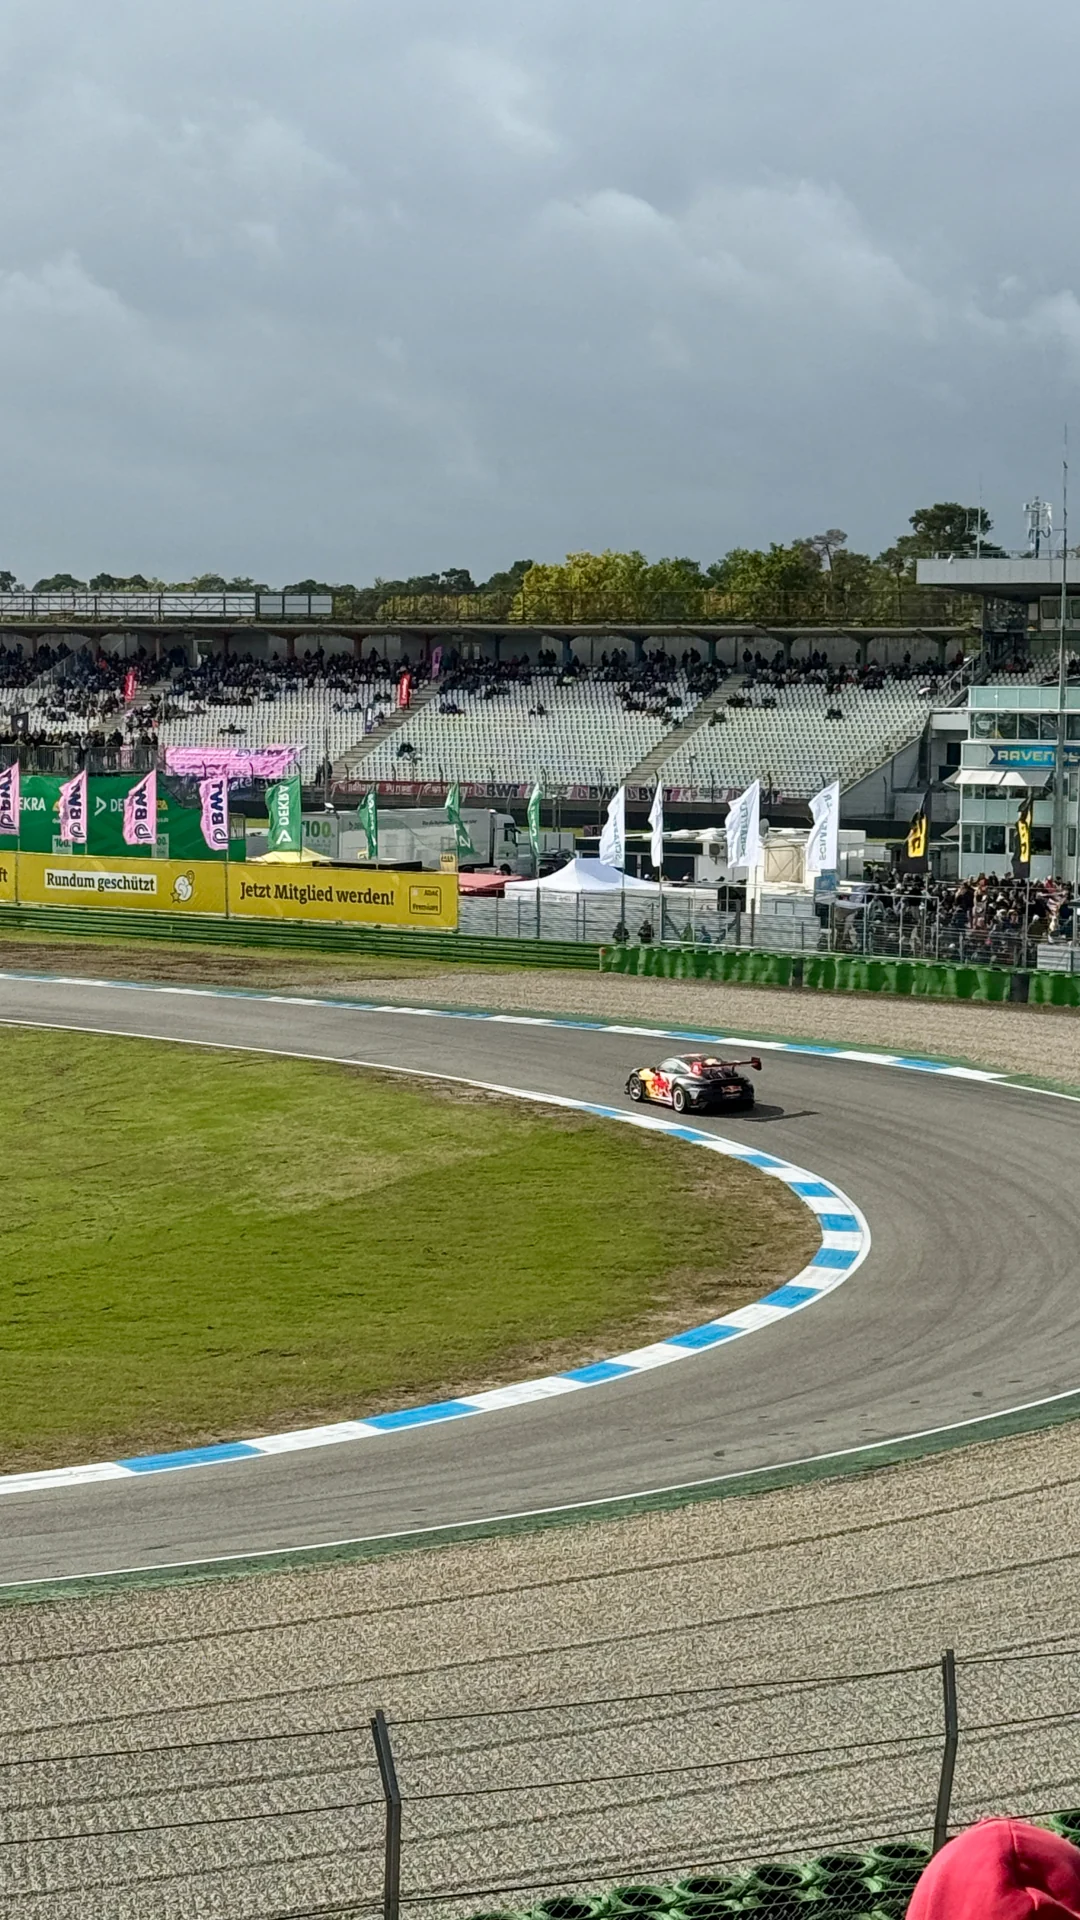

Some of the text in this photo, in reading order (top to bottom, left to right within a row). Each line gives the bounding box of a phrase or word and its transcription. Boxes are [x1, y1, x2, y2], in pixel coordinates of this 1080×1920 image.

[589, 786, 618, 800] BW
[19, 797, 46, 811] EKRA
[46, 872, 155, 892] Rundum geschützt
[240, 882, 394, 906] Jetzt Mitglied werden!
